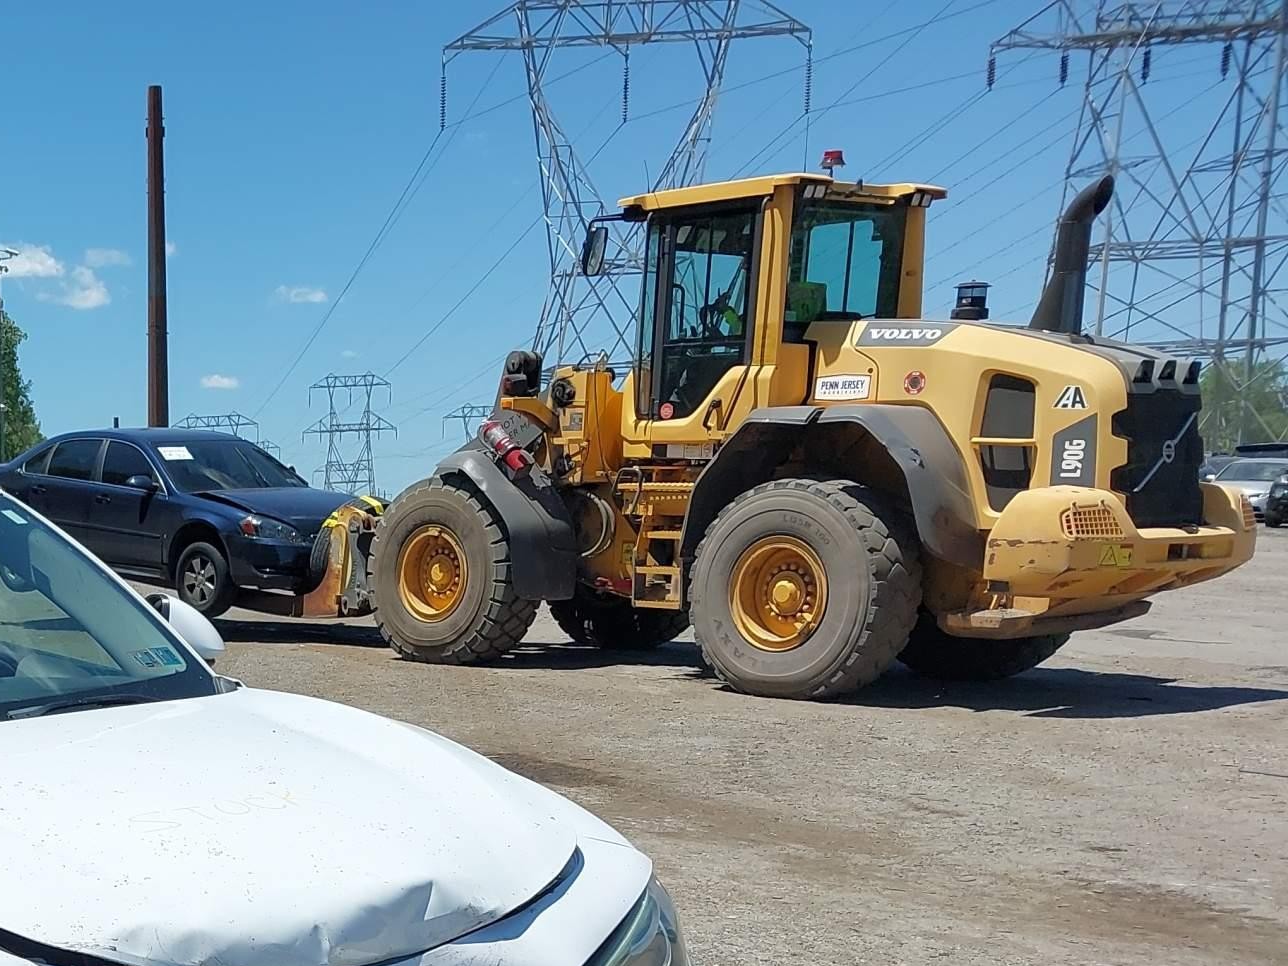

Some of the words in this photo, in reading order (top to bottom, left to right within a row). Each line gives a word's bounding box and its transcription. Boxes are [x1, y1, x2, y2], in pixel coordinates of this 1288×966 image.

[869, 328, 942, 340] VOLVO
[820, 380, 839, 391] PENN
[840, 379, 866, 390] JERSEY
[1060, 439, 1086, 478] L90G
